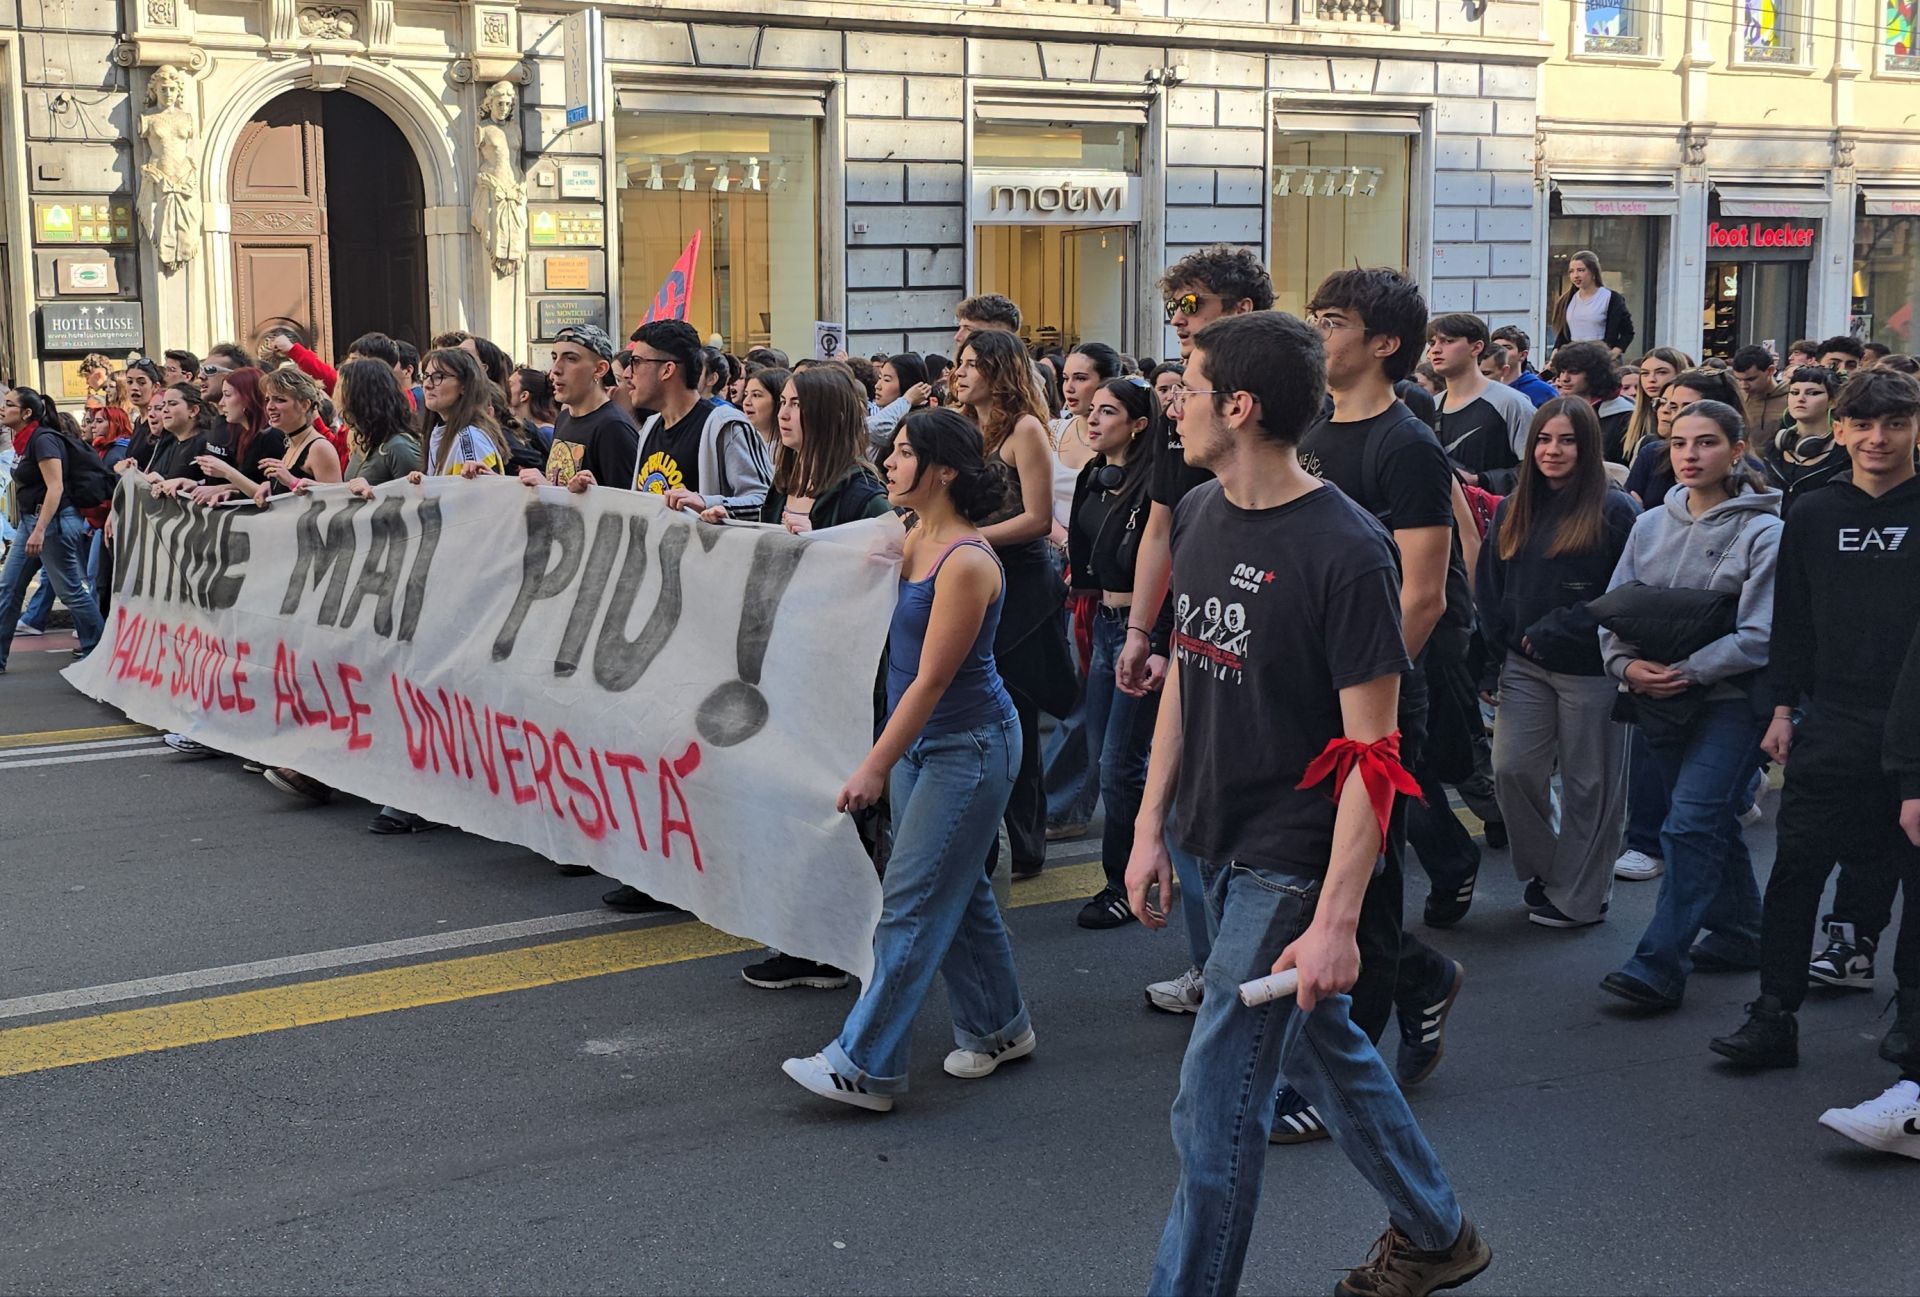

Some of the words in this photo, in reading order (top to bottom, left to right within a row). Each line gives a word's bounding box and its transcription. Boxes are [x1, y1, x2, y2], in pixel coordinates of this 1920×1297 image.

[570, 18, 581, 105] OLYMPIA
[567, 107, 587, 122] HOTEL
[991, 181, 1124, 212] motivi
[1708, 222, 1749, 247] Foot
[1753, 222, 1815, 247] Locker
[52, 318, 92, 331] HOTEL
[94, 317, 135, 331] SUISSE
[1838, 527, 1909, 551] EA7
[279, 494, 443, 642] MAI
[170, 622, 256, 714] SCUOLE
[274, 638, 373, 752] ALLE
